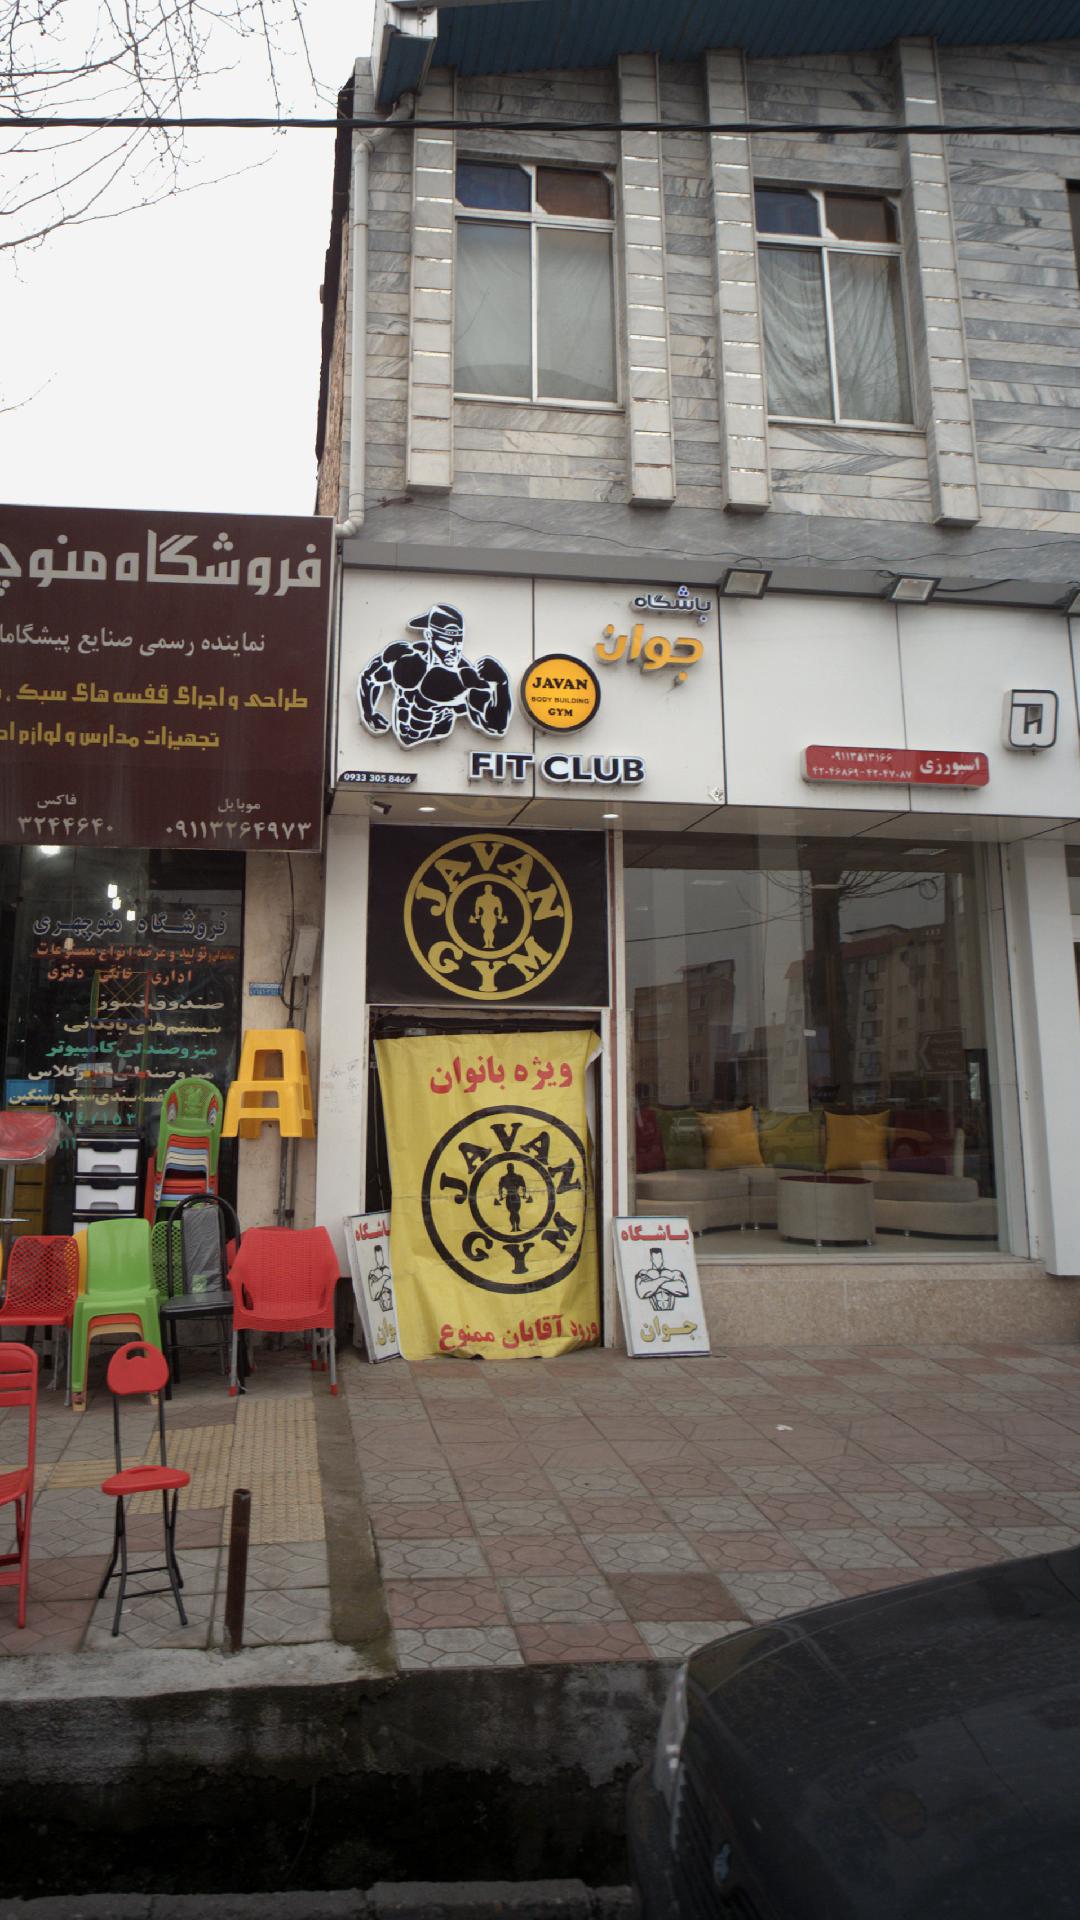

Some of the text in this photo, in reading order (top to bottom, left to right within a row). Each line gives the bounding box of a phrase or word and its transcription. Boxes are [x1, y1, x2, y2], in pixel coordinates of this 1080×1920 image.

[116, 529, 322, 597] فروشگاه
[633, 585, 712, 623] باشگاه
[77, 627, 133, 654] صنایع
[139, 637, 195, 656] رسمی
[201, 631, 265, 657] نماینده
[595, 623, 704, 682] جوان
[72, 682, 110, 703] های
[113, 683, 169, 705] قفسه
[532, 676, 588, 690] JAVAN
[173, 685, 225, 711] اجرای
[228, 694, 239, 711] و
[243, 687, 309, 712] طراحی
[554, 697, 590, 705] BUILDING
[547, 707, 573, 717] GYM
[19, 721, 62, 747] لوازم
[65, 731, 75, 747] و
[80, 723, 140, 748] مدارس
[144, 725, 220, 751] تجهیزات
[343, 773, 412, 784] 0933 305 8466
[471, 751, 646, 783] FIT CLUB
[37, 793, 77, 809] فاکس
[218, 798, 261, 813] موبایل
[166, 819, 312, 841] ۰۹۱۱۳۲۶۴۹۷۳
[415, 842, 564, 921] JAVAN
[33, 909, 228, 942] فروشگاه منوچهری
[151, 968, 192, 985] اداری
[428, 936, 552, 992] GYM
[430, 1055, 573, 1094] ویژه بانوان
[440, 1122, 582, 1205] JAVAN
[462, 1212, 578, 1275] GYM
[621, 1223, 690, 1245] باشگاه
[438, 1322, 496, 1352] ممنوع
[502, 1314, 563, 1350] آقایان
[640, 1315, 698, 1343] جوان
